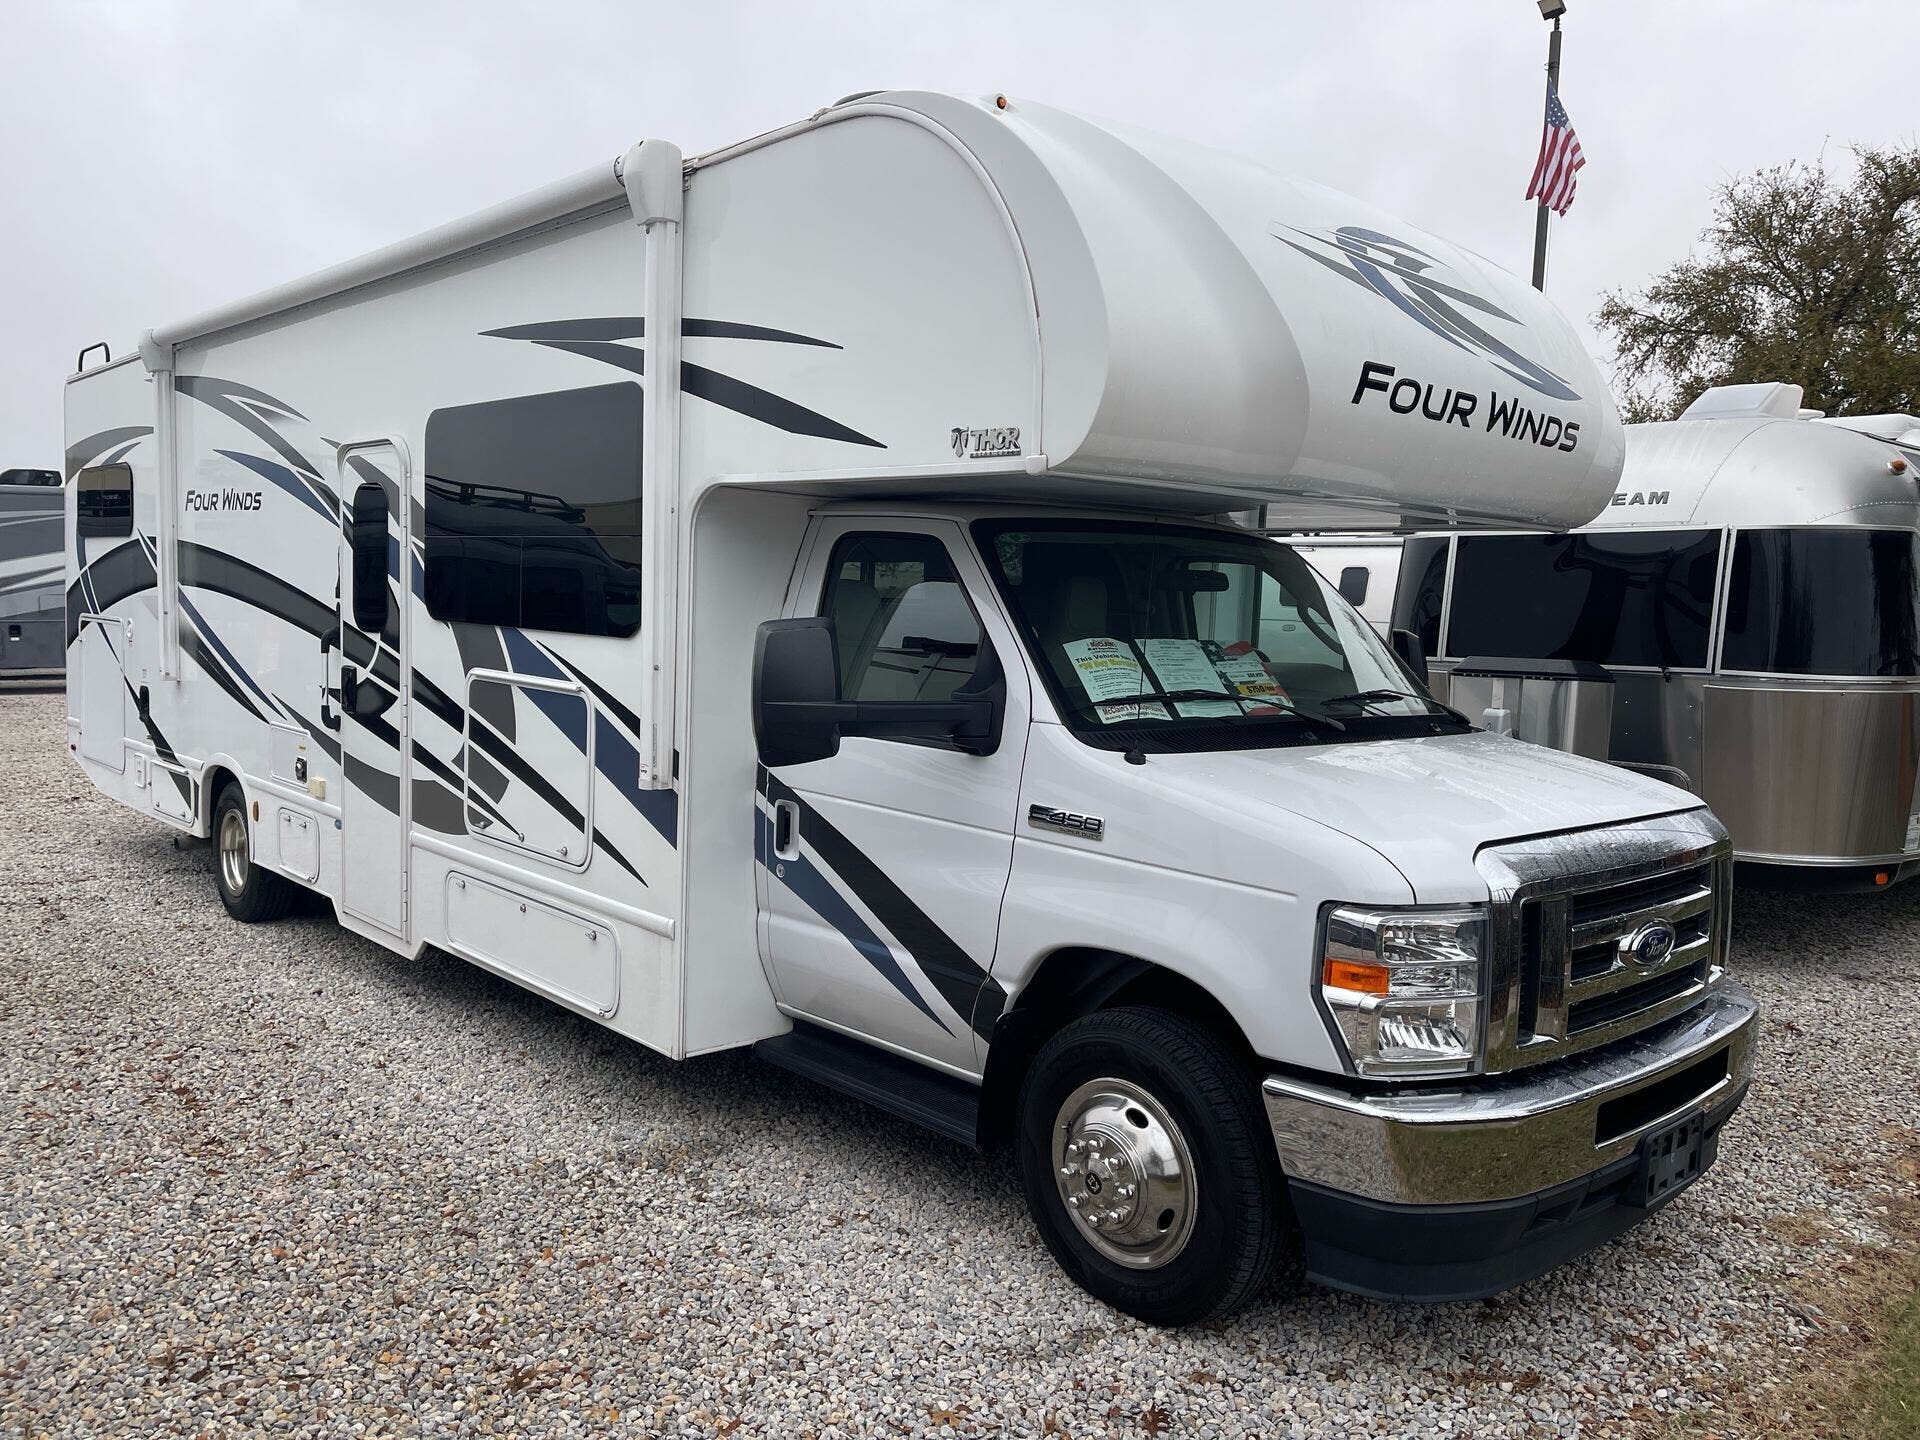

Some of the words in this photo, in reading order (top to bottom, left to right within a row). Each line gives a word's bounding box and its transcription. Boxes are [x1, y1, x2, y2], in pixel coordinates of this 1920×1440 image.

[1351, 360, 1478, 428] FOUR
[1486, 391, 1580, 452] WINDS
[970, 426, 1020, 451] THOR
[185, 489, 219, 511] FOUR
[222, 488, 262, 511] WINDS
[1075, 656, 1093, 664] This
